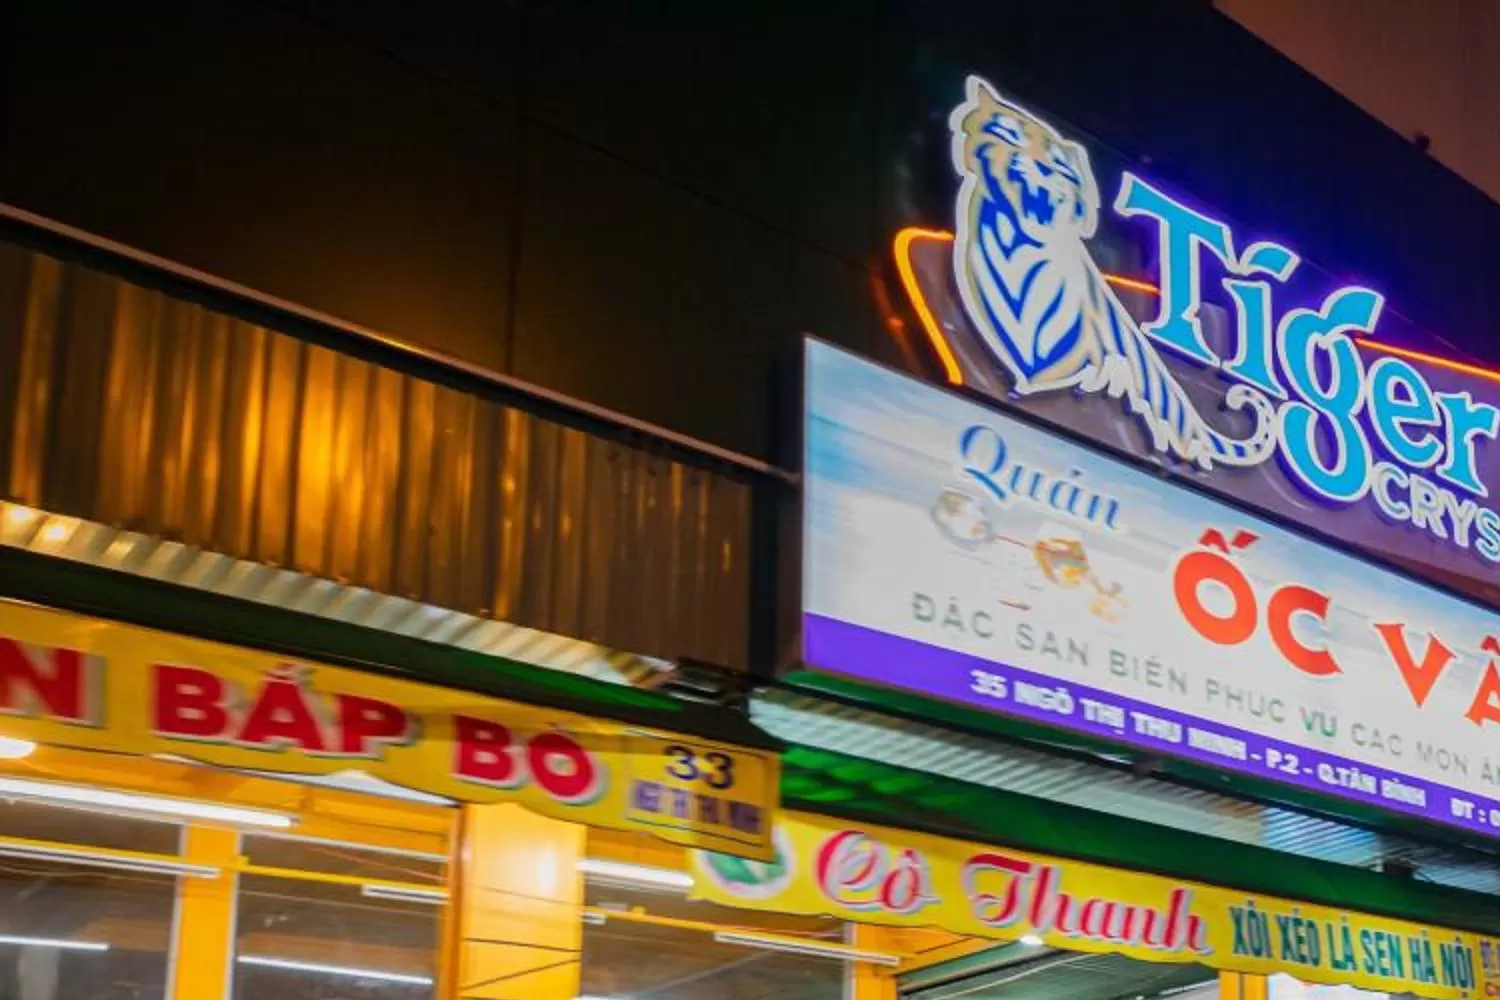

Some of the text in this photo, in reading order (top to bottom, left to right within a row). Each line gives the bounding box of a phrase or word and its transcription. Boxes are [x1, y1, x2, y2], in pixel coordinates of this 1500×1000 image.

[959, 423, 1122, 531] Quán
[1174, 528, 1344, 677] ỐC
[971, 669, 1007, 698] 35
[663, 745, 735, 789] 33
[815, 829, 1212, 954] Cô Thanh
[1229, 899, 1272, 960] XÔI
[1360, 928, 1405, 979] SEN
[1440, 936, 1476, 998] NỘI
